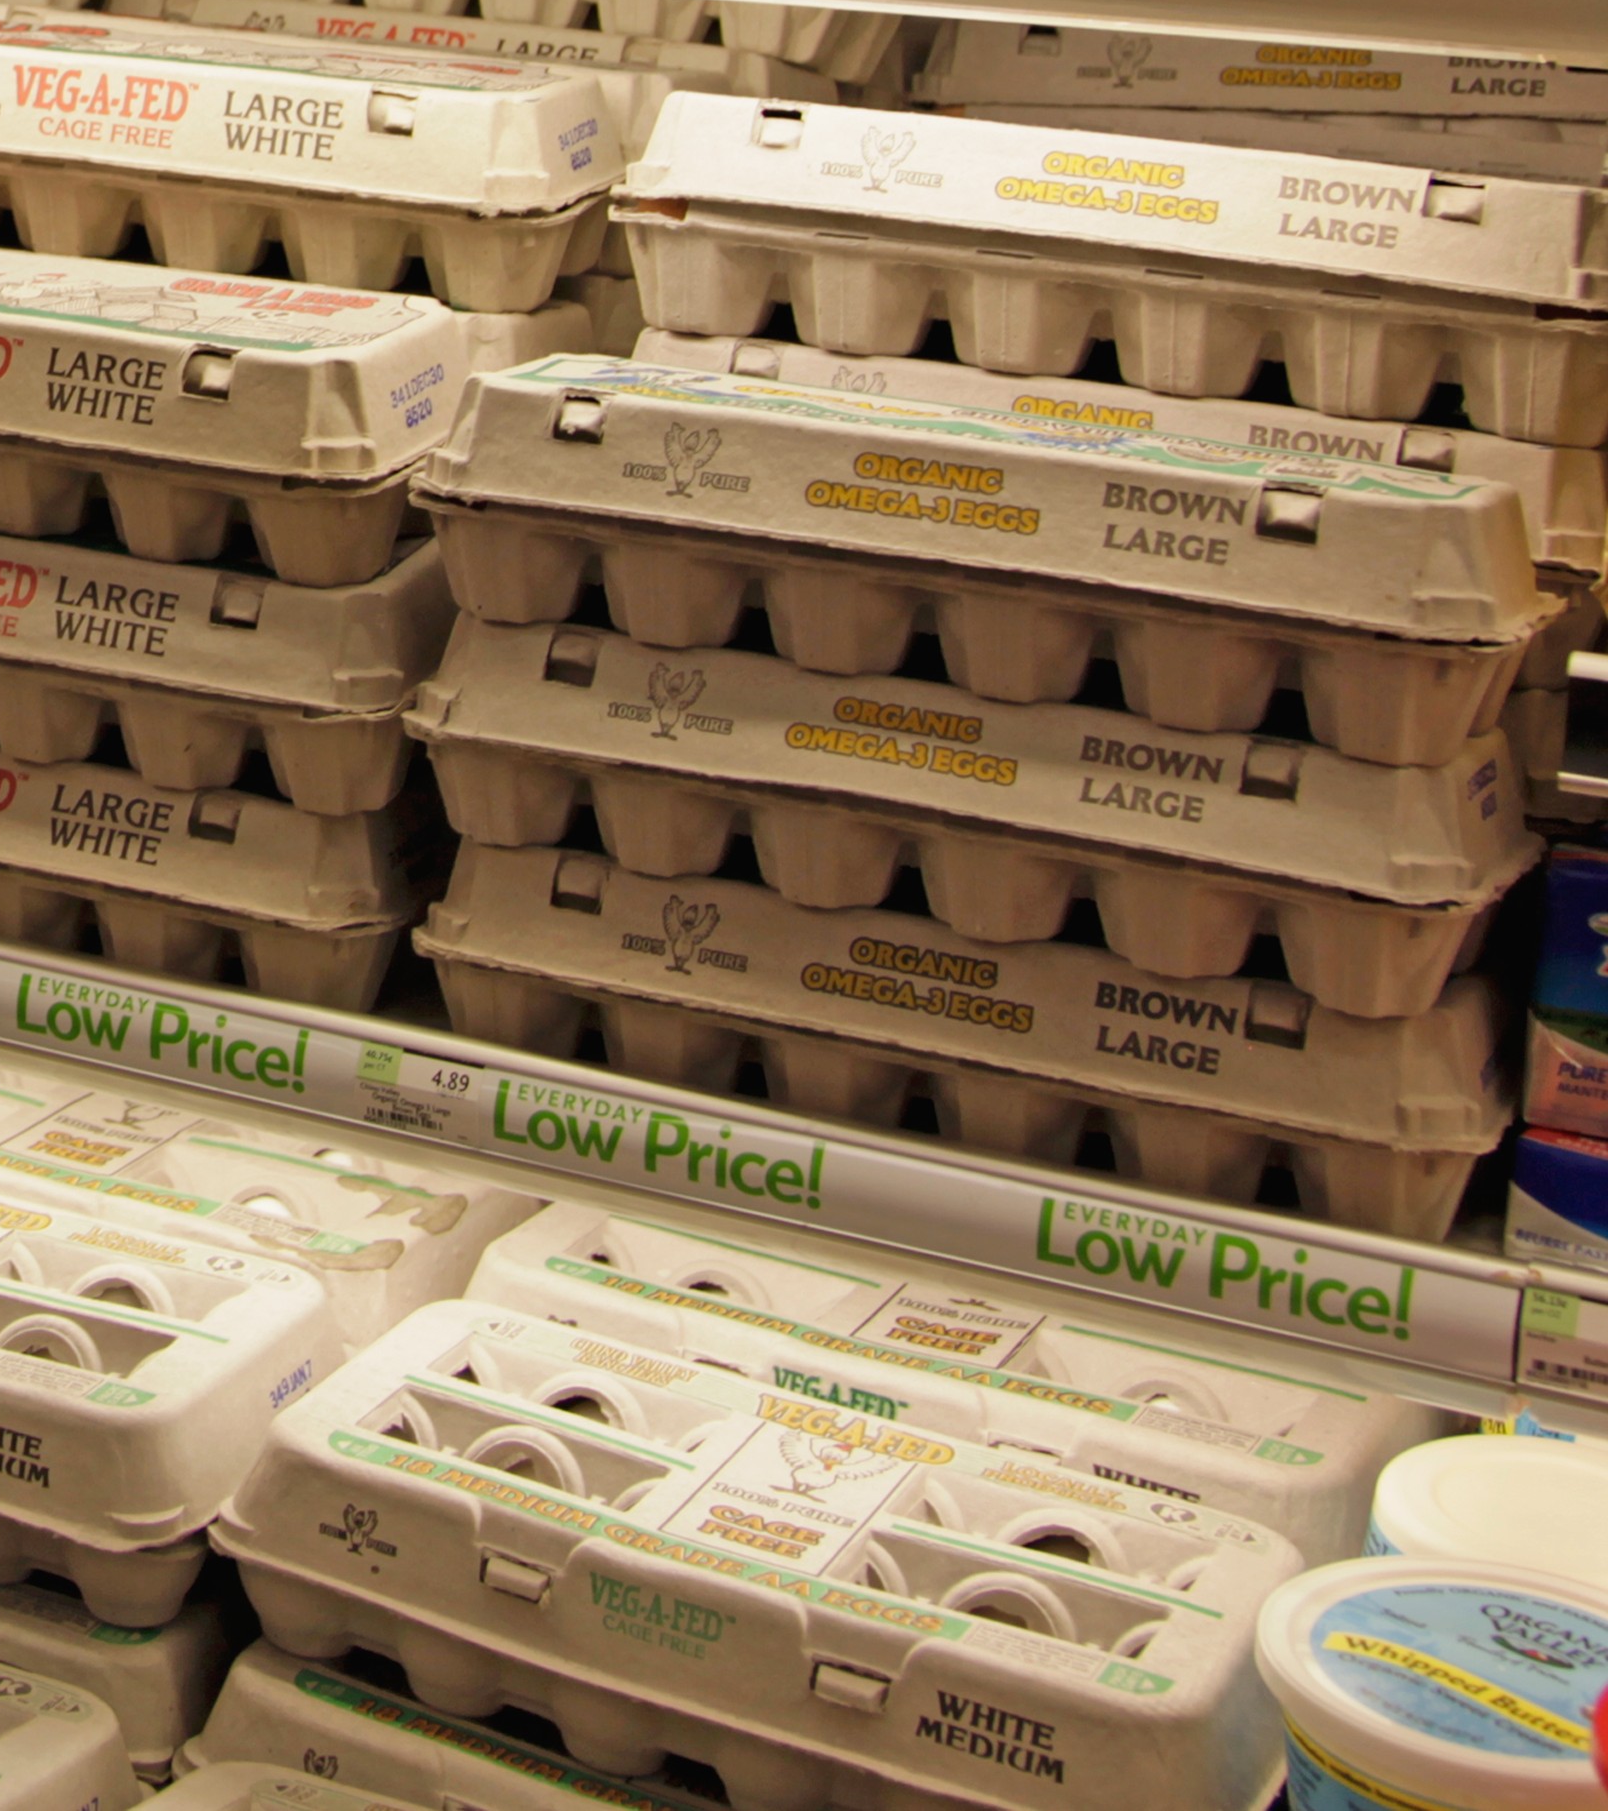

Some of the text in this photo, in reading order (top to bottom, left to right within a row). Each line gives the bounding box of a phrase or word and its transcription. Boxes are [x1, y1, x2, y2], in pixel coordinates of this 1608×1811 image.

[1043, 151, 1184, 187] ORGANIC
[994, 175, 1219, 224] OMEGA-3 EGGS
[1277, 175, 1415, 214] BROWN
[1278, 213, 1399, 249] LARGE
[47, 347, 166, 390] LARGE
[47, 382, 155, 425] WHITE
[517, 1082, 644, 1126] EVERYDAY
[492, 1079, 825, 1210] Low Price!
[384, 1454, 946, 1638] 18 MEDIUM GRADE AA EGGS
[589, 1569, 724, 1643] VEG-A-FED
[602, 1614, 706, 1660] CAGE FREE
[1345, 1636, 1489, 1695] Whipped
[936, 1689, 1055, 1753] WHITE
[914, 1713, 1066, 1786] MEDIUM
